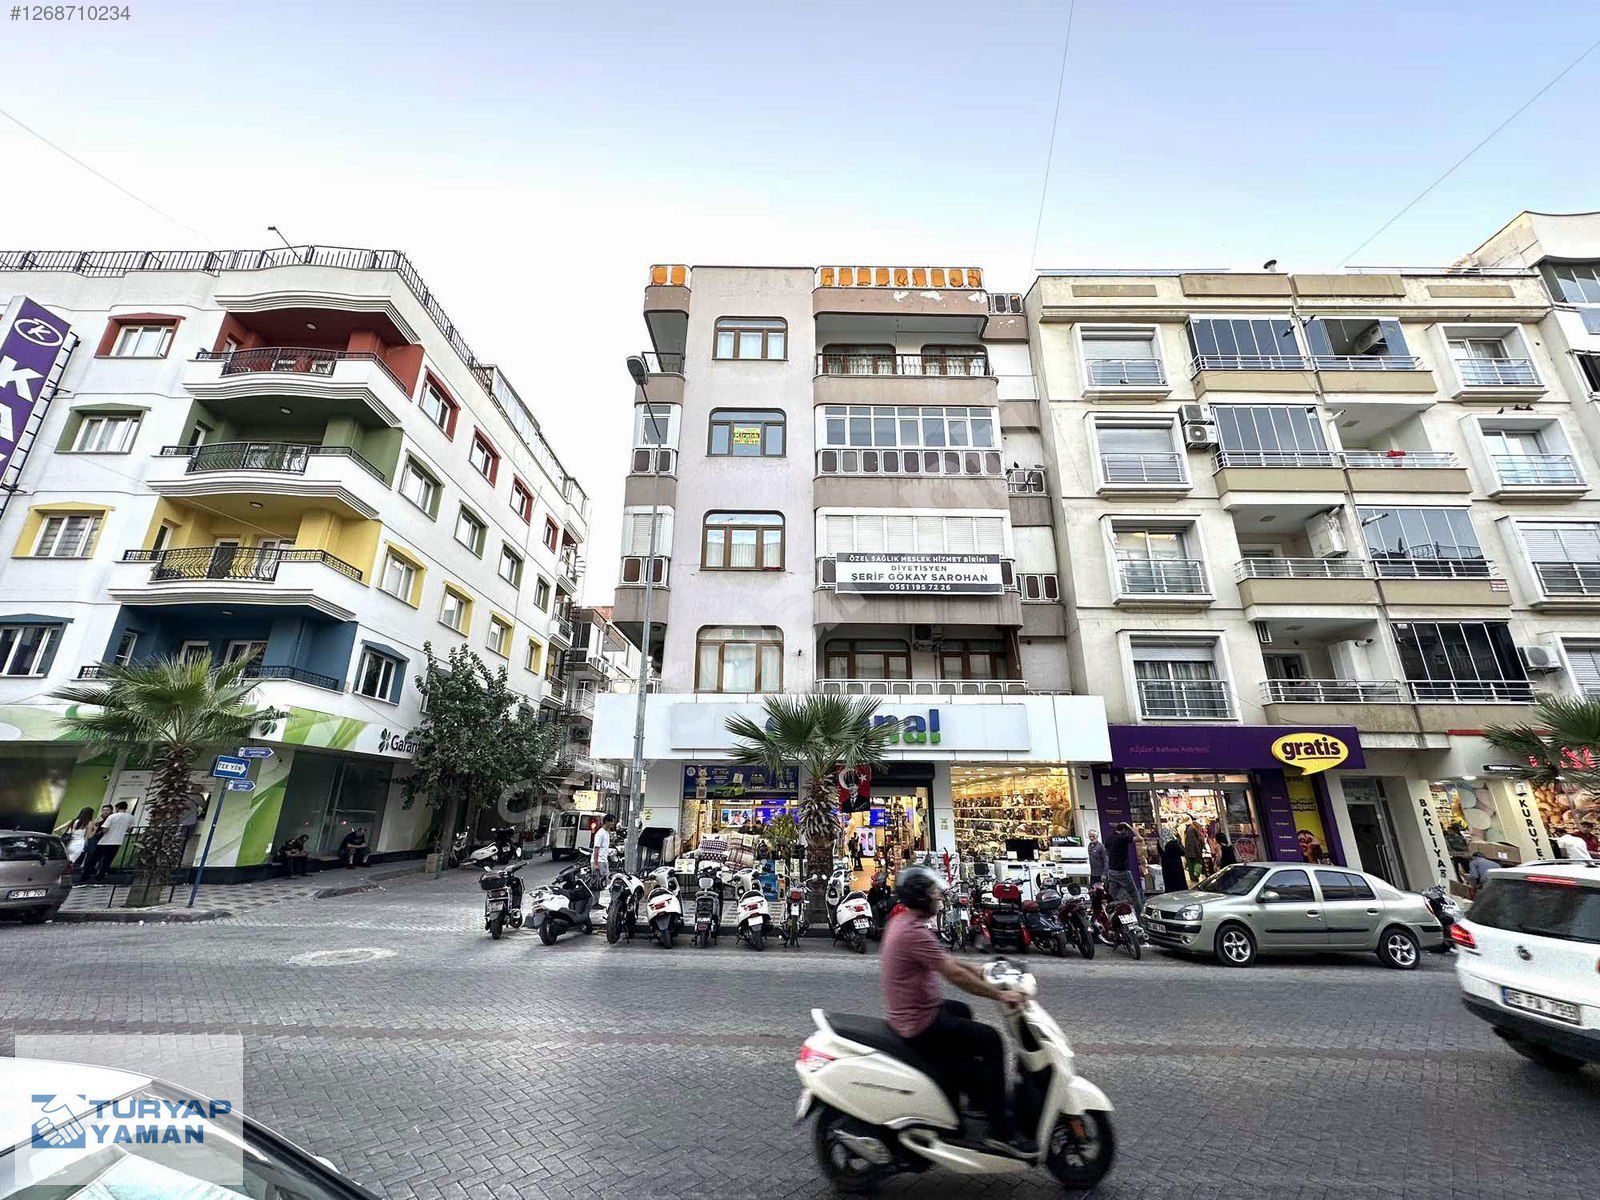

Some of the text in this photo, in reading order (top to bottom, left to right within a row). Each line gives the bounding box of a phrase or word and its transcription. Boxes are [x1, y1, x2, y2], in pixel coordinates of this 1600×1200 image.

[849, 554, 870, 562] ÖZEL
[851, 572, 988, 582] ŞERİF GÖKAY SAROHAN
[1281, 736, 1341, 761] gratis
[1518, 799, 1546, 861] KURUYE
